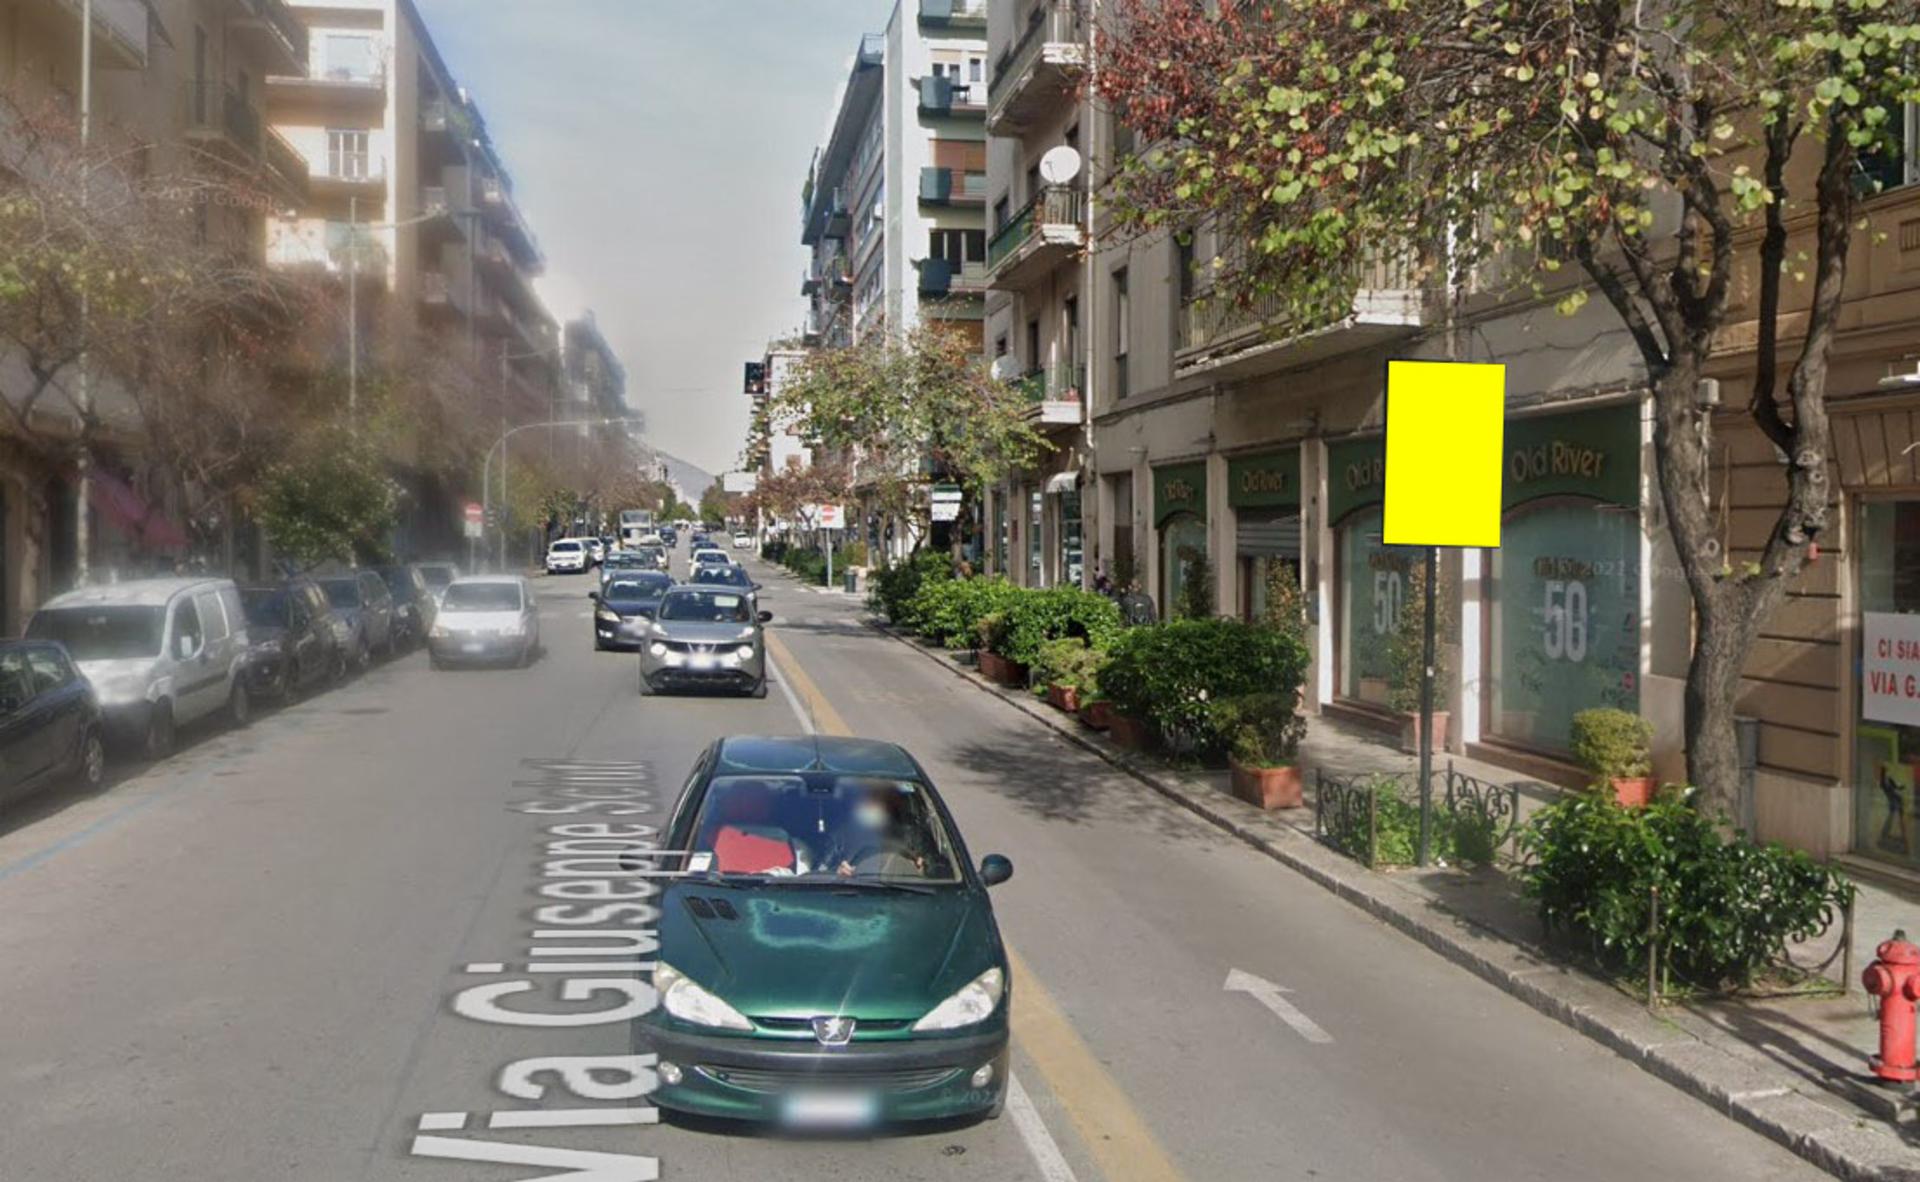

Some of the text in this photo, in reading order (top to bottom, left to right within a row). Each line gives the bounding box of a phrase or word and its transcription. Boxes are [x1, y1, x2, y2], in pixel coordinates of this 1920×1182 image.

[1345, 458, 1371, 491] Old
[1511, 439, 1604, 483] Old River
[1374, 570, 1402, 635] 50
[1544, 579, 1588, 663] 50
[1878, 639, 1892, 659] CI
[1870, 670, 1898, 697] VIA
